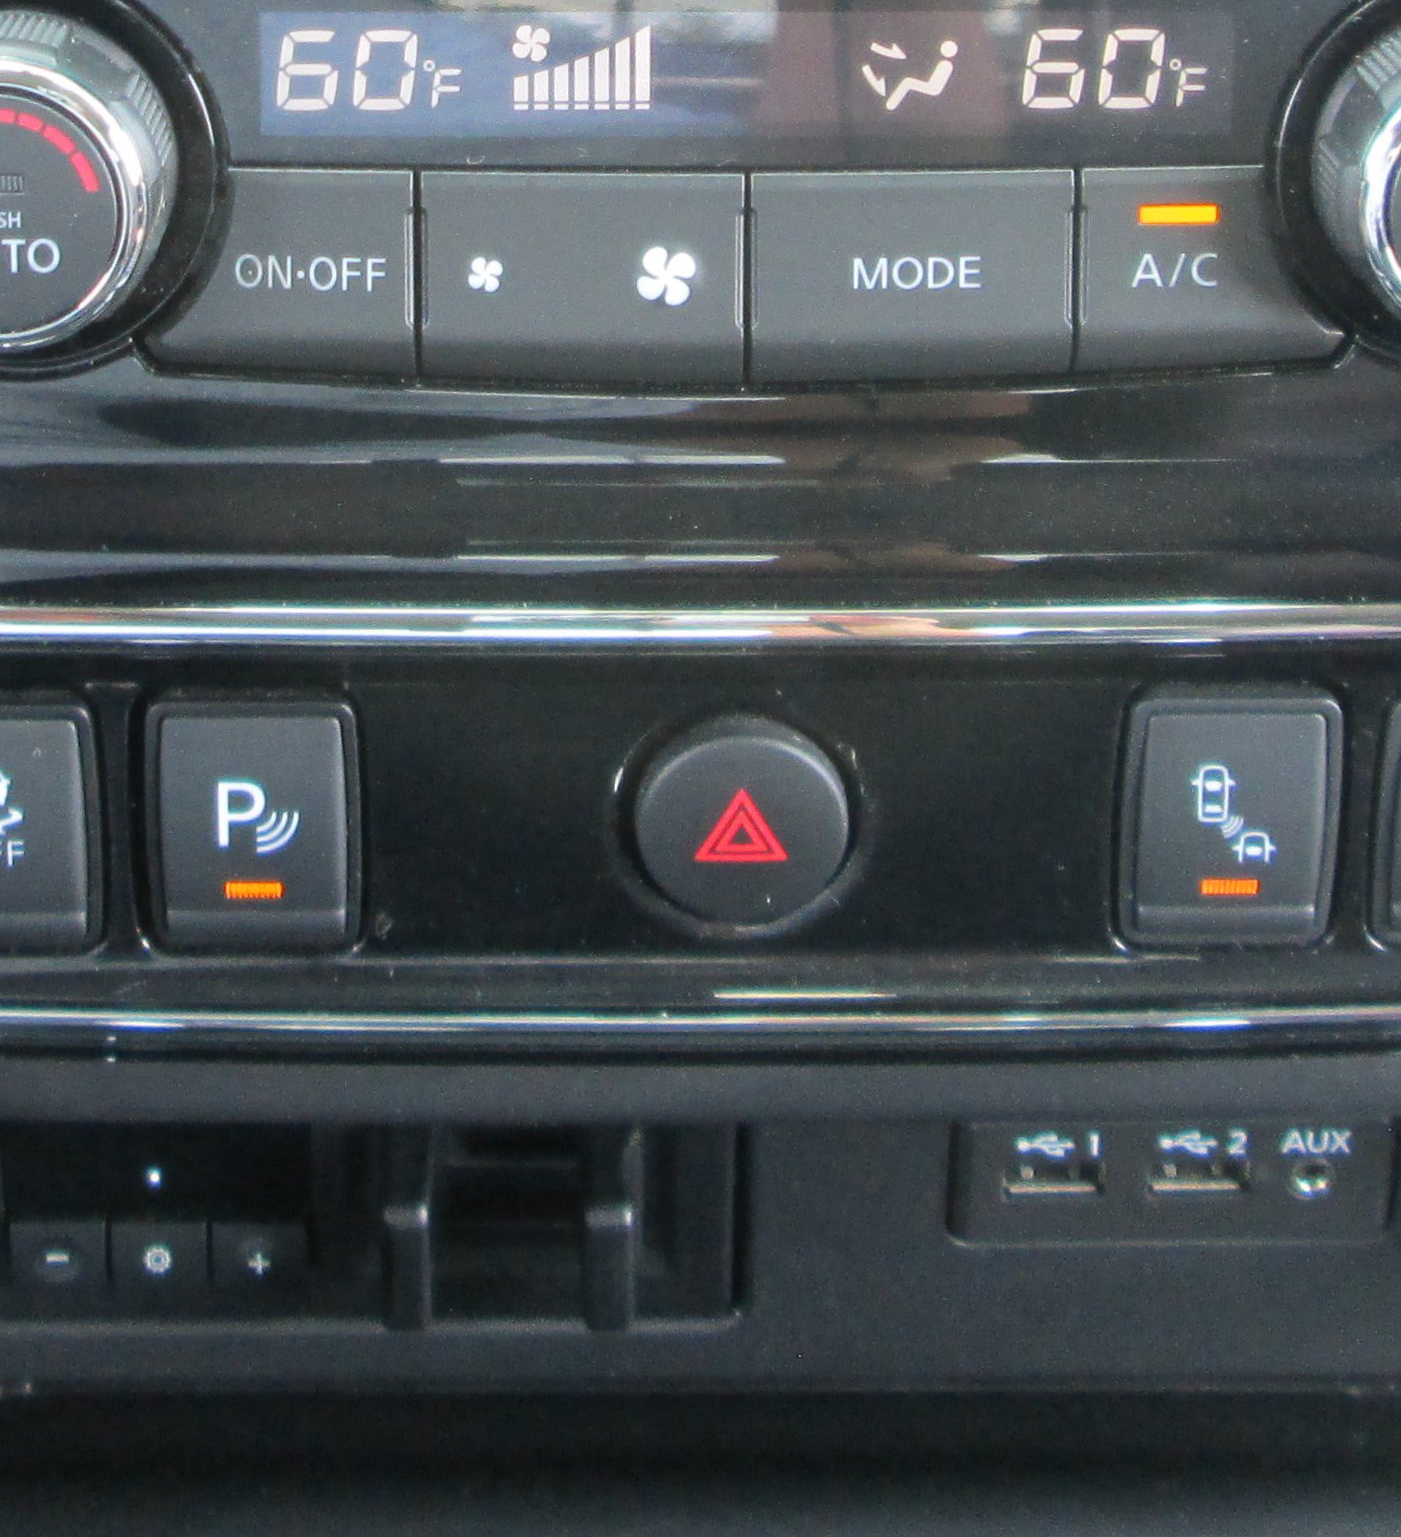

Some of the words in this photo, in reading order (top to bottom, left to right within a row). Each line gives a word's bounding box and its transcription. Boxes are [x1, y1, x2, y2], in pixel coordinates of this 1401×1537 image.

[852, 257, 982, 291] MODE
[1131, 253, 1218, 288] A/C
[216, 781, 264, 848] P
[1086, 1130, 1101, 1155] 1
[1227, 1129, 1249, 1156] 2
[1280, 1129, 1352, 1156] AUX
